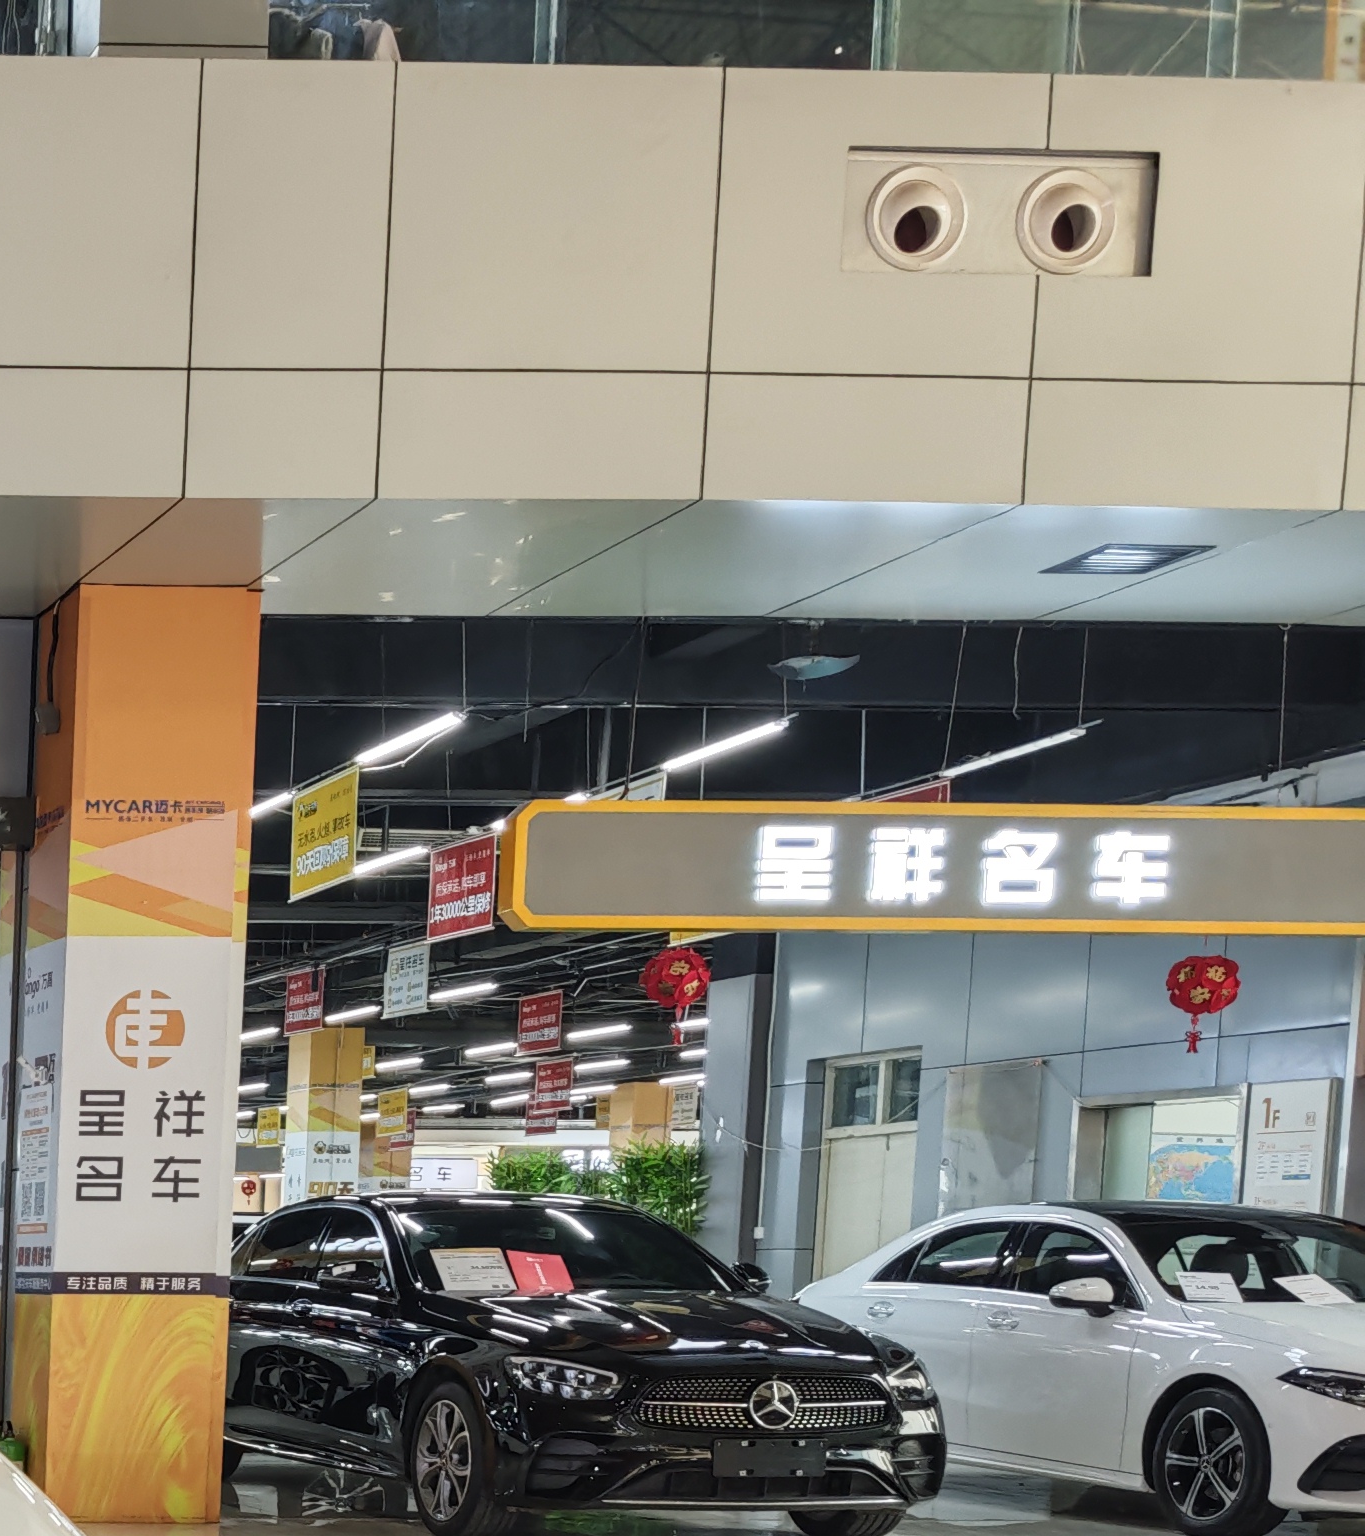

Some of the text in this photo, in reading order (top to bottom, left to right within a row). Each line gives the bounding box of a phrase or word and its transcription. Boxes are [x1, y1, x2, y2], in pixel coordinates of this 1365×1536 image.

[754, 824, 1172, 906] 呈祥名车
[78, 1089, 206, 1138] 呈祥
[1262, 1097, 1281, 1129] 1F
[75, 1155, 202, 1203] 名车
[66, 1276, 128, 1291] 专注品质
[140, 1276, 202, 1292] 精于服务
